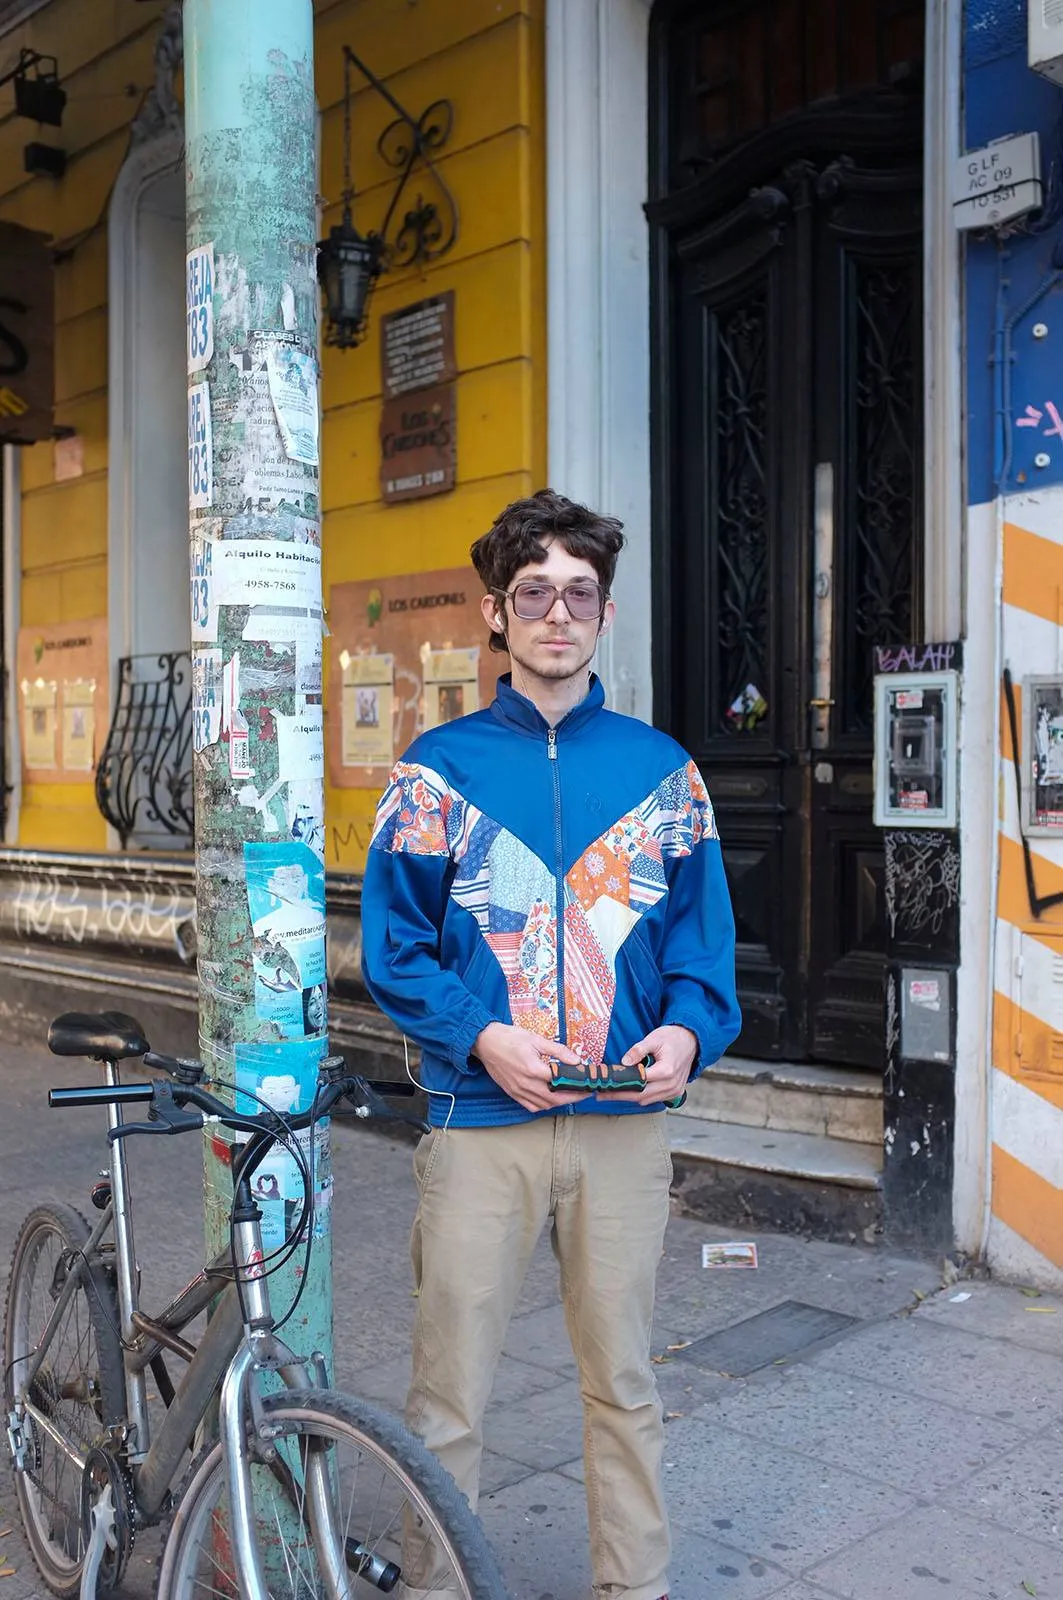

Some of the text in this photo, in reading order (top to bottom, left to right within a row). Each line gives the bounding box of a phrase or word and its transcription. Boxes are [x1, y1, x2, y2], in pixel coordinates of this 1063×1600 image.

[225, 549, 271, 559] Alquilo
[244, 580, 296, 591] 4958-7568
[389, 599, 407, 613] LOS
